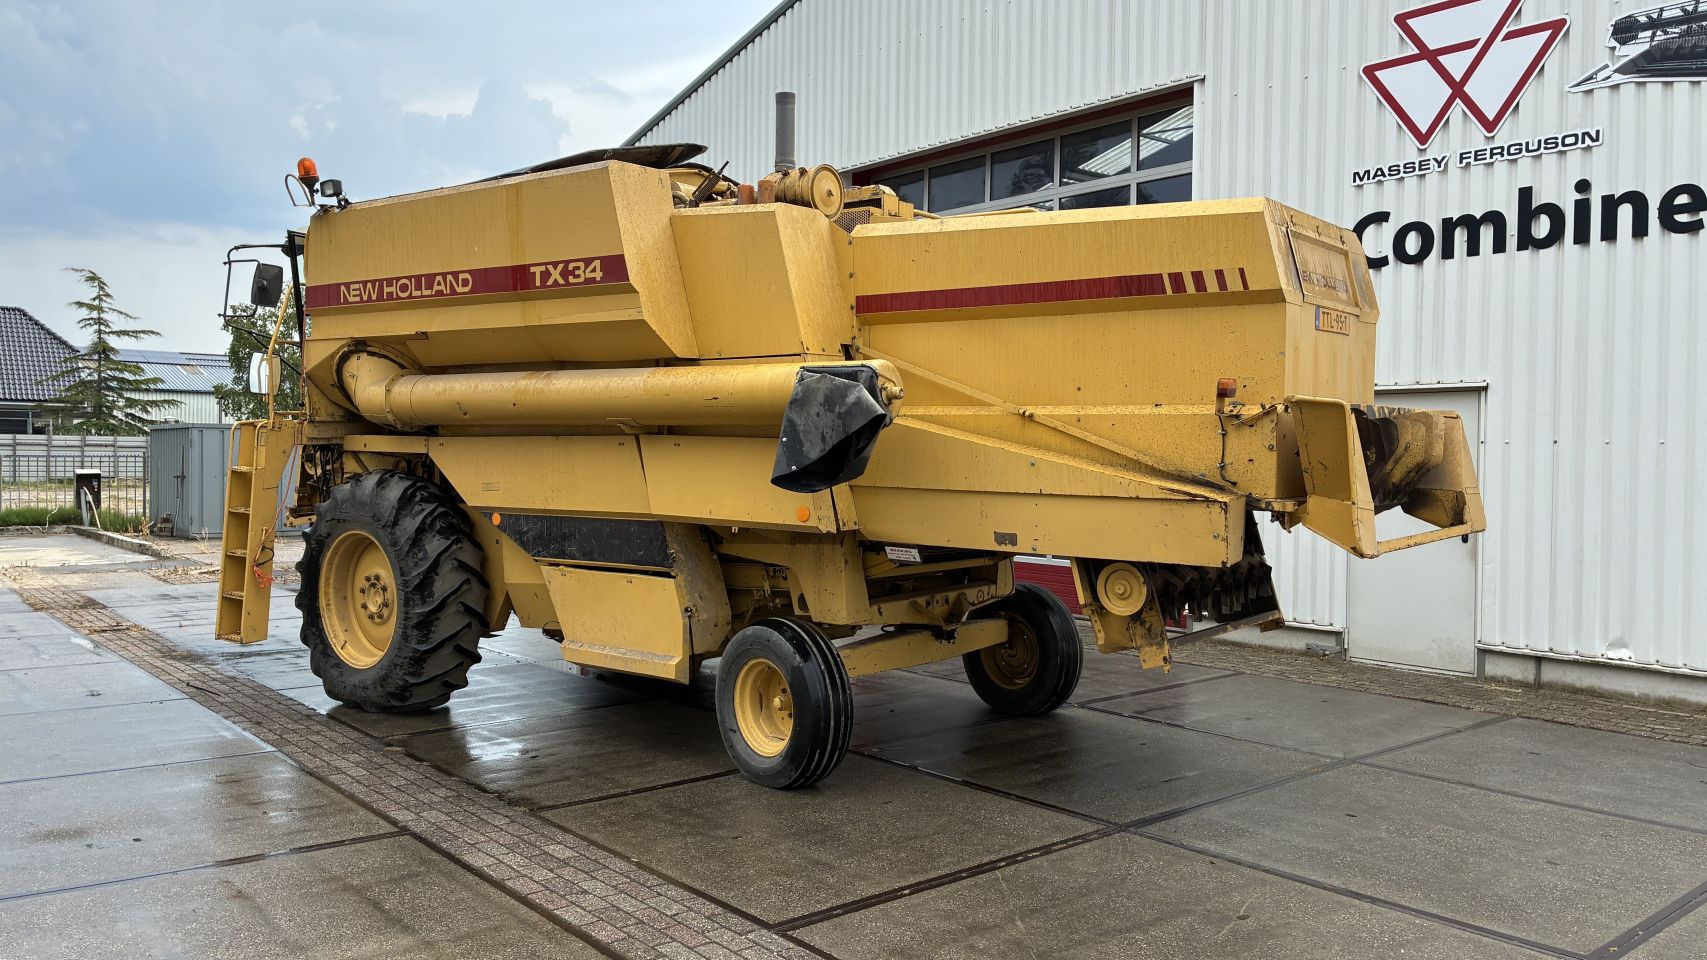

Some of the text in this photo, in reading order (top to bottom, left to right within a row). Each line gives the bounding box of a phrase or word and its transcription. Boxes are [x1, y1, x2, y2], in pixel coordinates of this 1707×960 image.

[1352, 129, 1601, 184] MASSEY FERGUSON
[1352, 178, 1707, 269] Combine
[340, 281, 379, 303] NEW
[383, 273, 473, 299] HOLLAND
